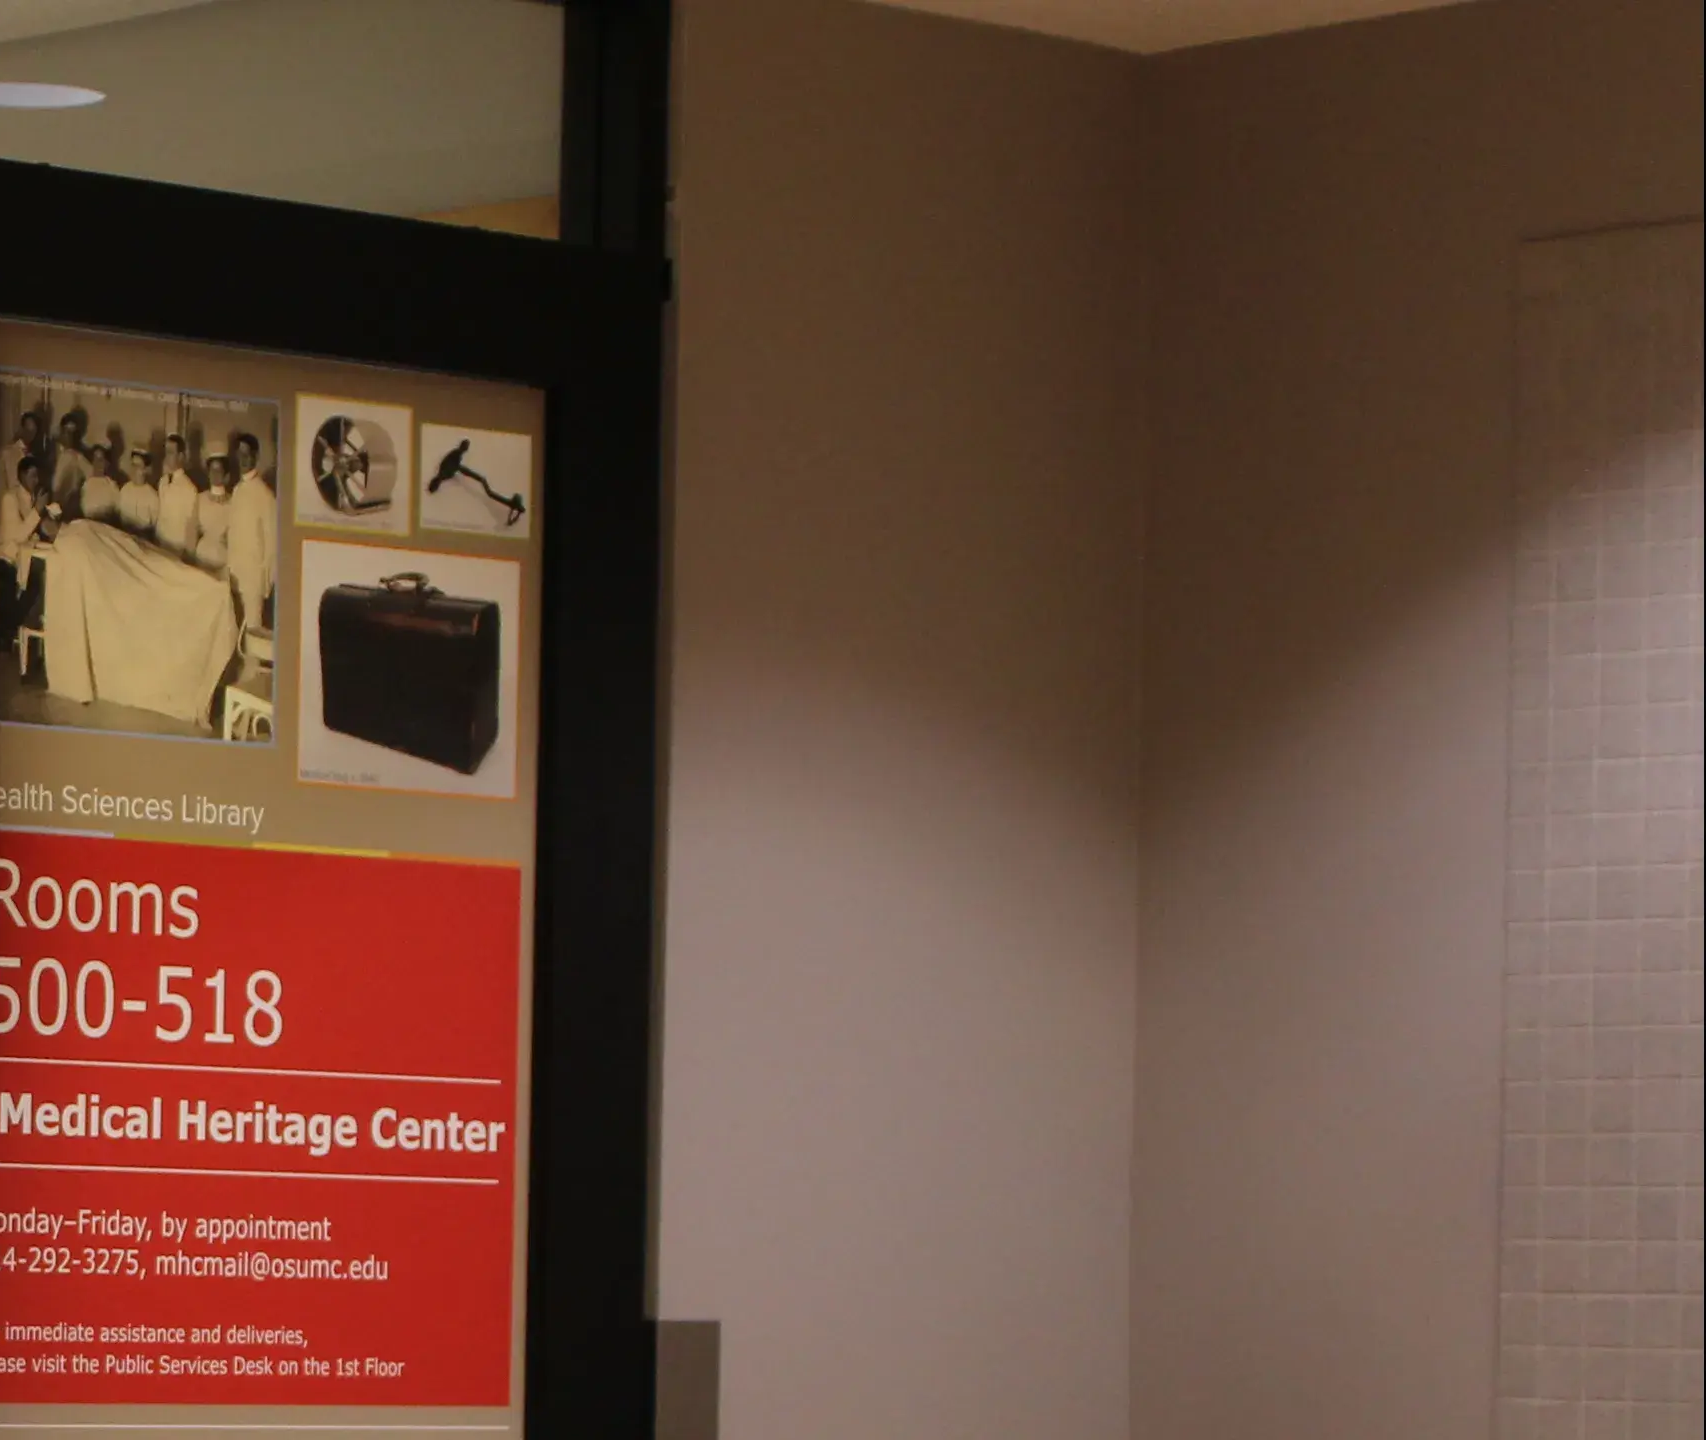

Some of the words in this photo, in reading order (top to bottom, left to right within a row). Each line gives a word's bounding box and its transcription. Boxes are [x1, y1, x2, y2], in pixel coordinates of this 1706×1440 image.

[61, 785, 174, 821] Sciences
[181, 794, 266, 835] Library
[178, 1098, 359, 1157] Heritage
[369, 1106, 506, 1153] Center
[161, 1210, 188, 1244] by
[194, 1215, 332, 1245] appointment
[155, 1251, 389, 1282] mhcmail@osumc.edu
[4, 1321, 94, 1343] immediate
[99, 1323, 187, 1344] assistance
[190, 1324, 222, 1345] and
[226, 1325, 309, 1349] deliveries,
[31, 1353, 68, 1374] visit
[71, 1354, 100, 1375] the
[105, 1354, 155, 1376] Public
[159, 1355, 229, 1376] Services
[233, 1355, 274, 1377] Desk
[278, 1361, 300, 1377] on
[302, 1356, 331, 1378] the
[336, 1357, 360, 1378] 1st
[364, 1357, 406, 1379] Floor
